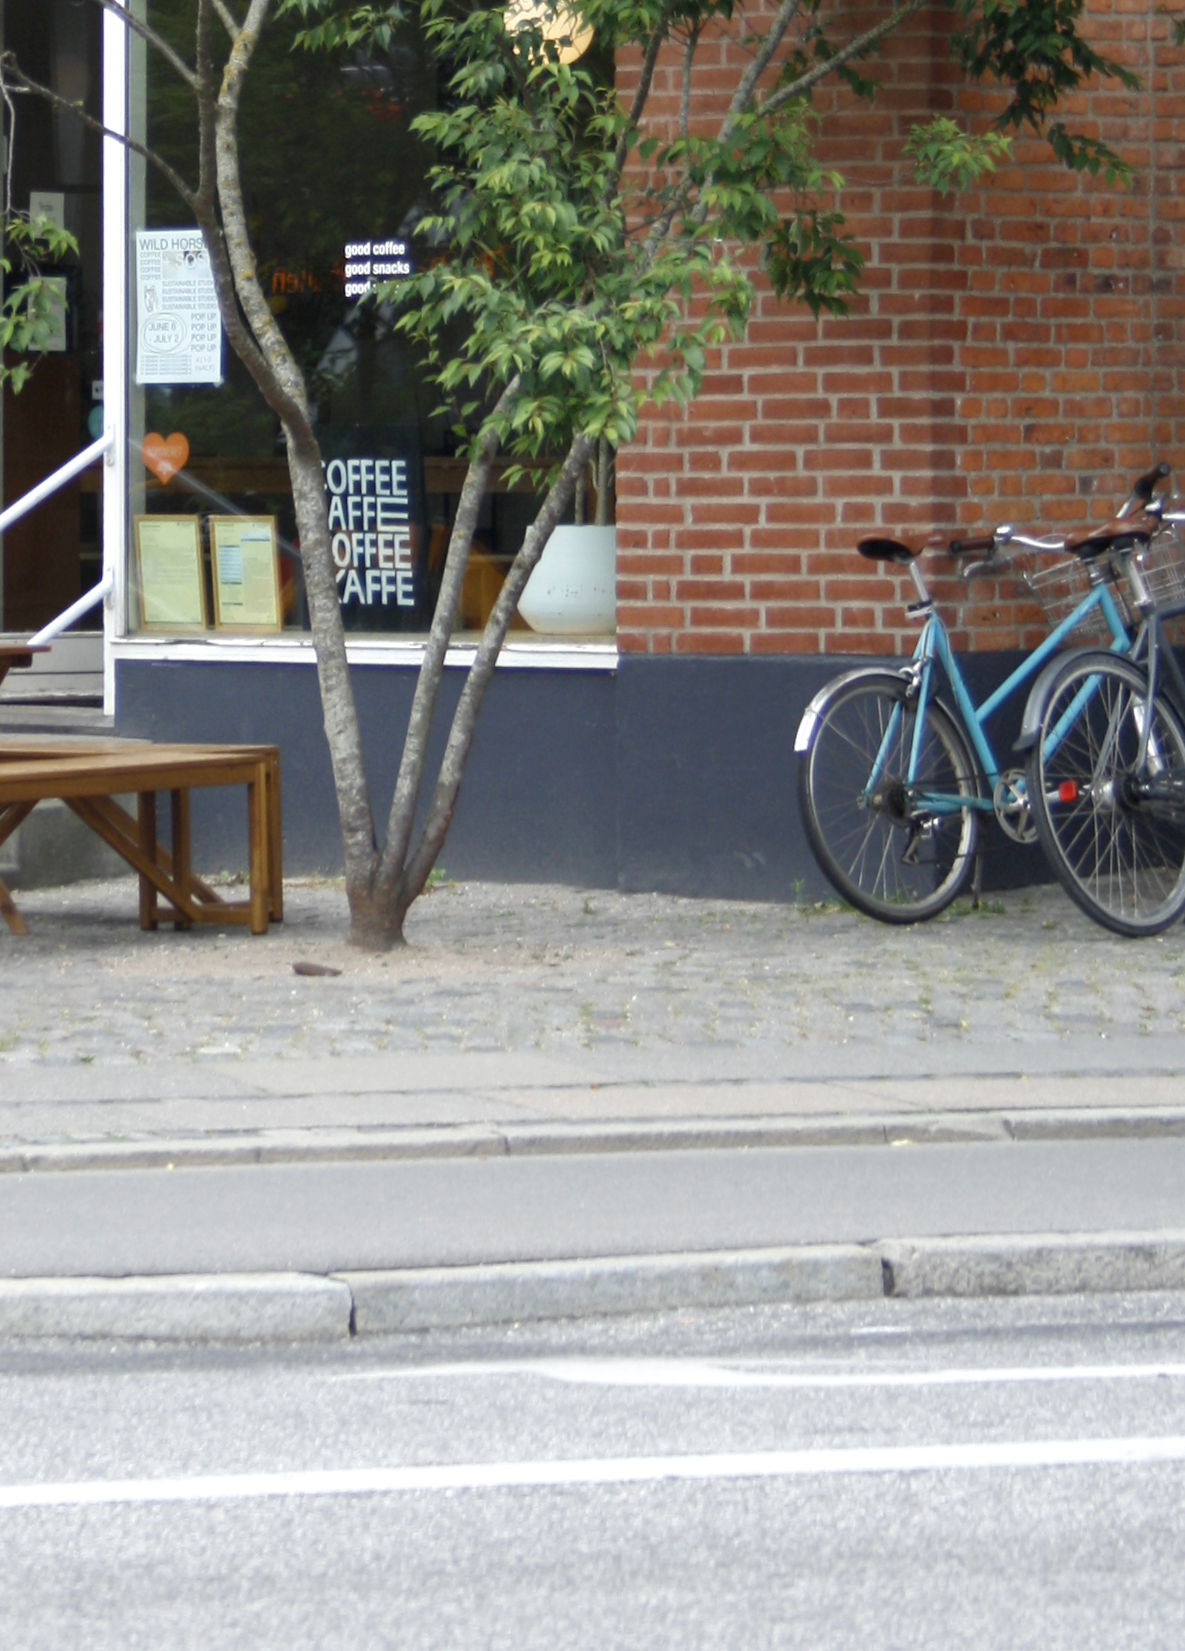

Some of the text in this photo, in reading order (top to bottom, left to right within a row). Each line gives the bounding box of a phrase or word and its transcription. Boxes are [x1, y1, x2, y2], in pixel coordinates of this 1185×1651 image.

[139, 238, 205, 251] WILD HORS
[345, 240, 405, 259] good coffee
[345, 260, 410, 278] good snacks
[345, 281, 371, 297] good
[190, 313, 217, 321] POP UP
[148, 322, 169, 332] JUNE
[190, 323, 217, 331] POP UP
[153, 334, 173, 344] JULY
[190, 333, 217, 342] POP UP
[190, 344, 217, 352] POP UP
[321, 459, 408, 496] OFFEE
[328, 496, 410, 532] AFFE
[331, 532, 412, 569] OFFEE
